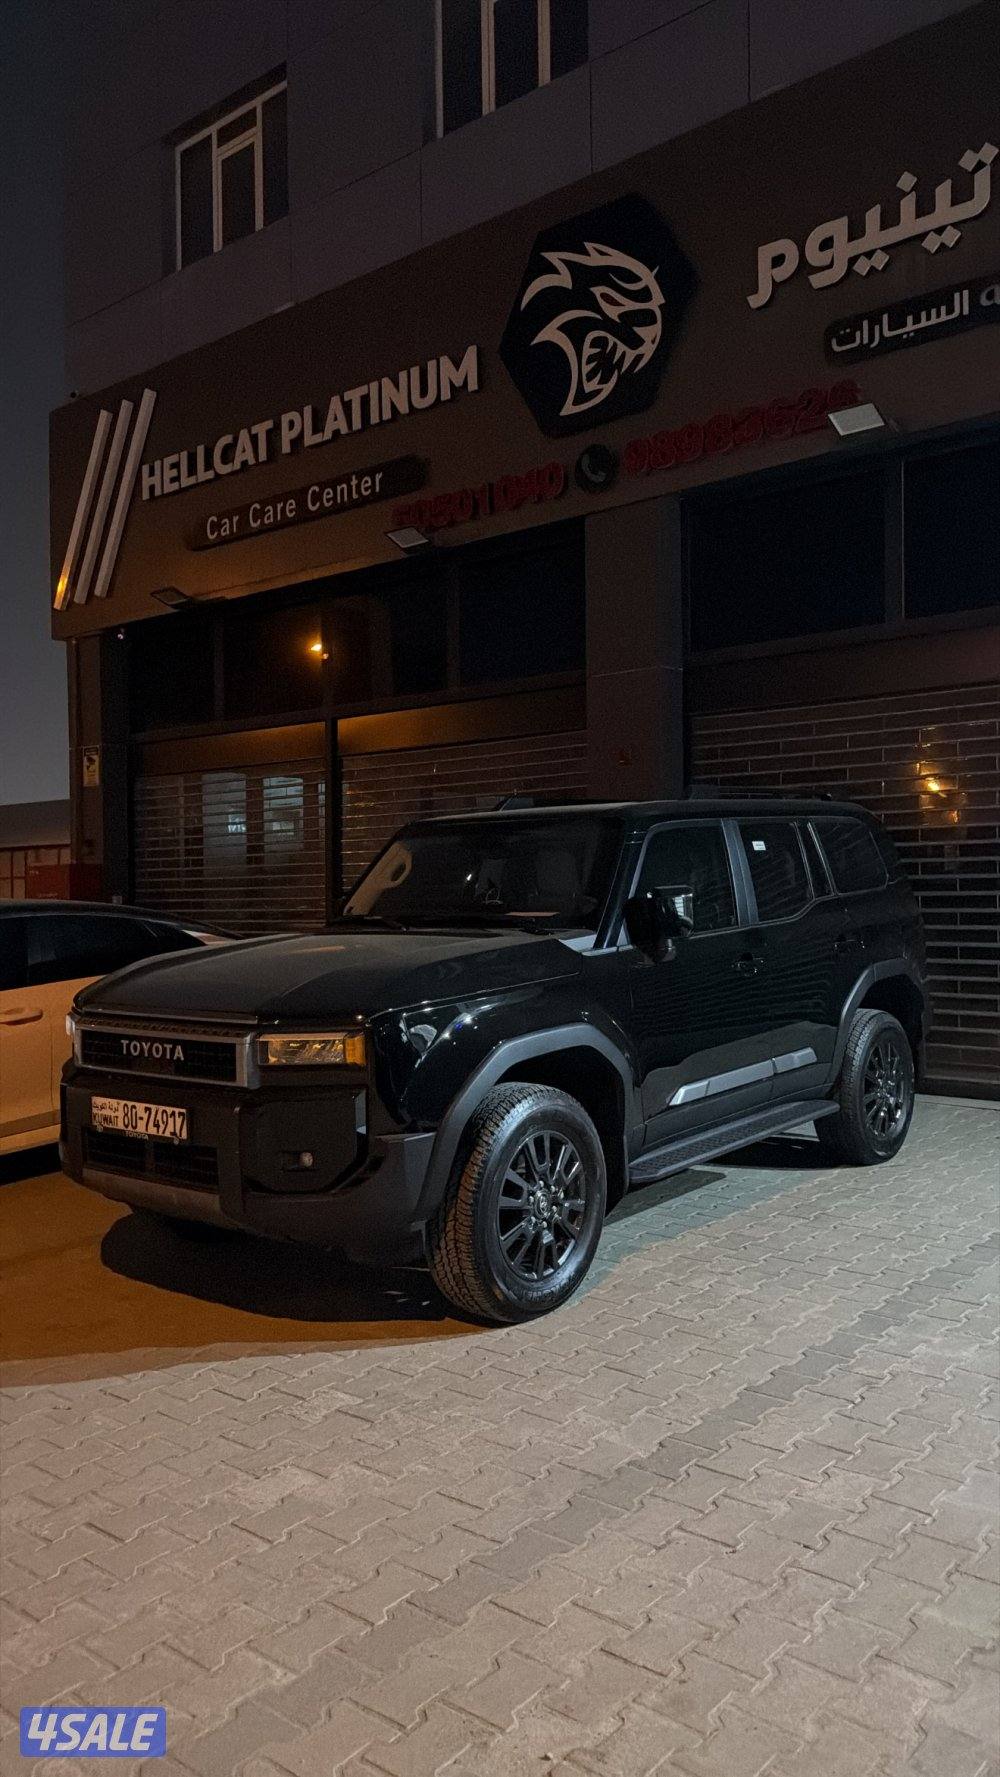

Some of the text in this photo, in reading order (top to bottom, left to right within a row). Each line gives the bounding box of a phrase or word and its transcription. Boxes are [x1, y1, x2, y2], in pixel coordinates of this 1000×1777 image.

[830, 289, 970, 353] السيارات
[141, 345, 480, 501] HELLCAT PLATINUM
[206, 469, 385, 541] Car Care Center
[120, 1039, 184, 1061] TOYOTA
[92, 1111, 119, 1128] KUWAIT
[122, 1103, 186, 1138] 80-74917
